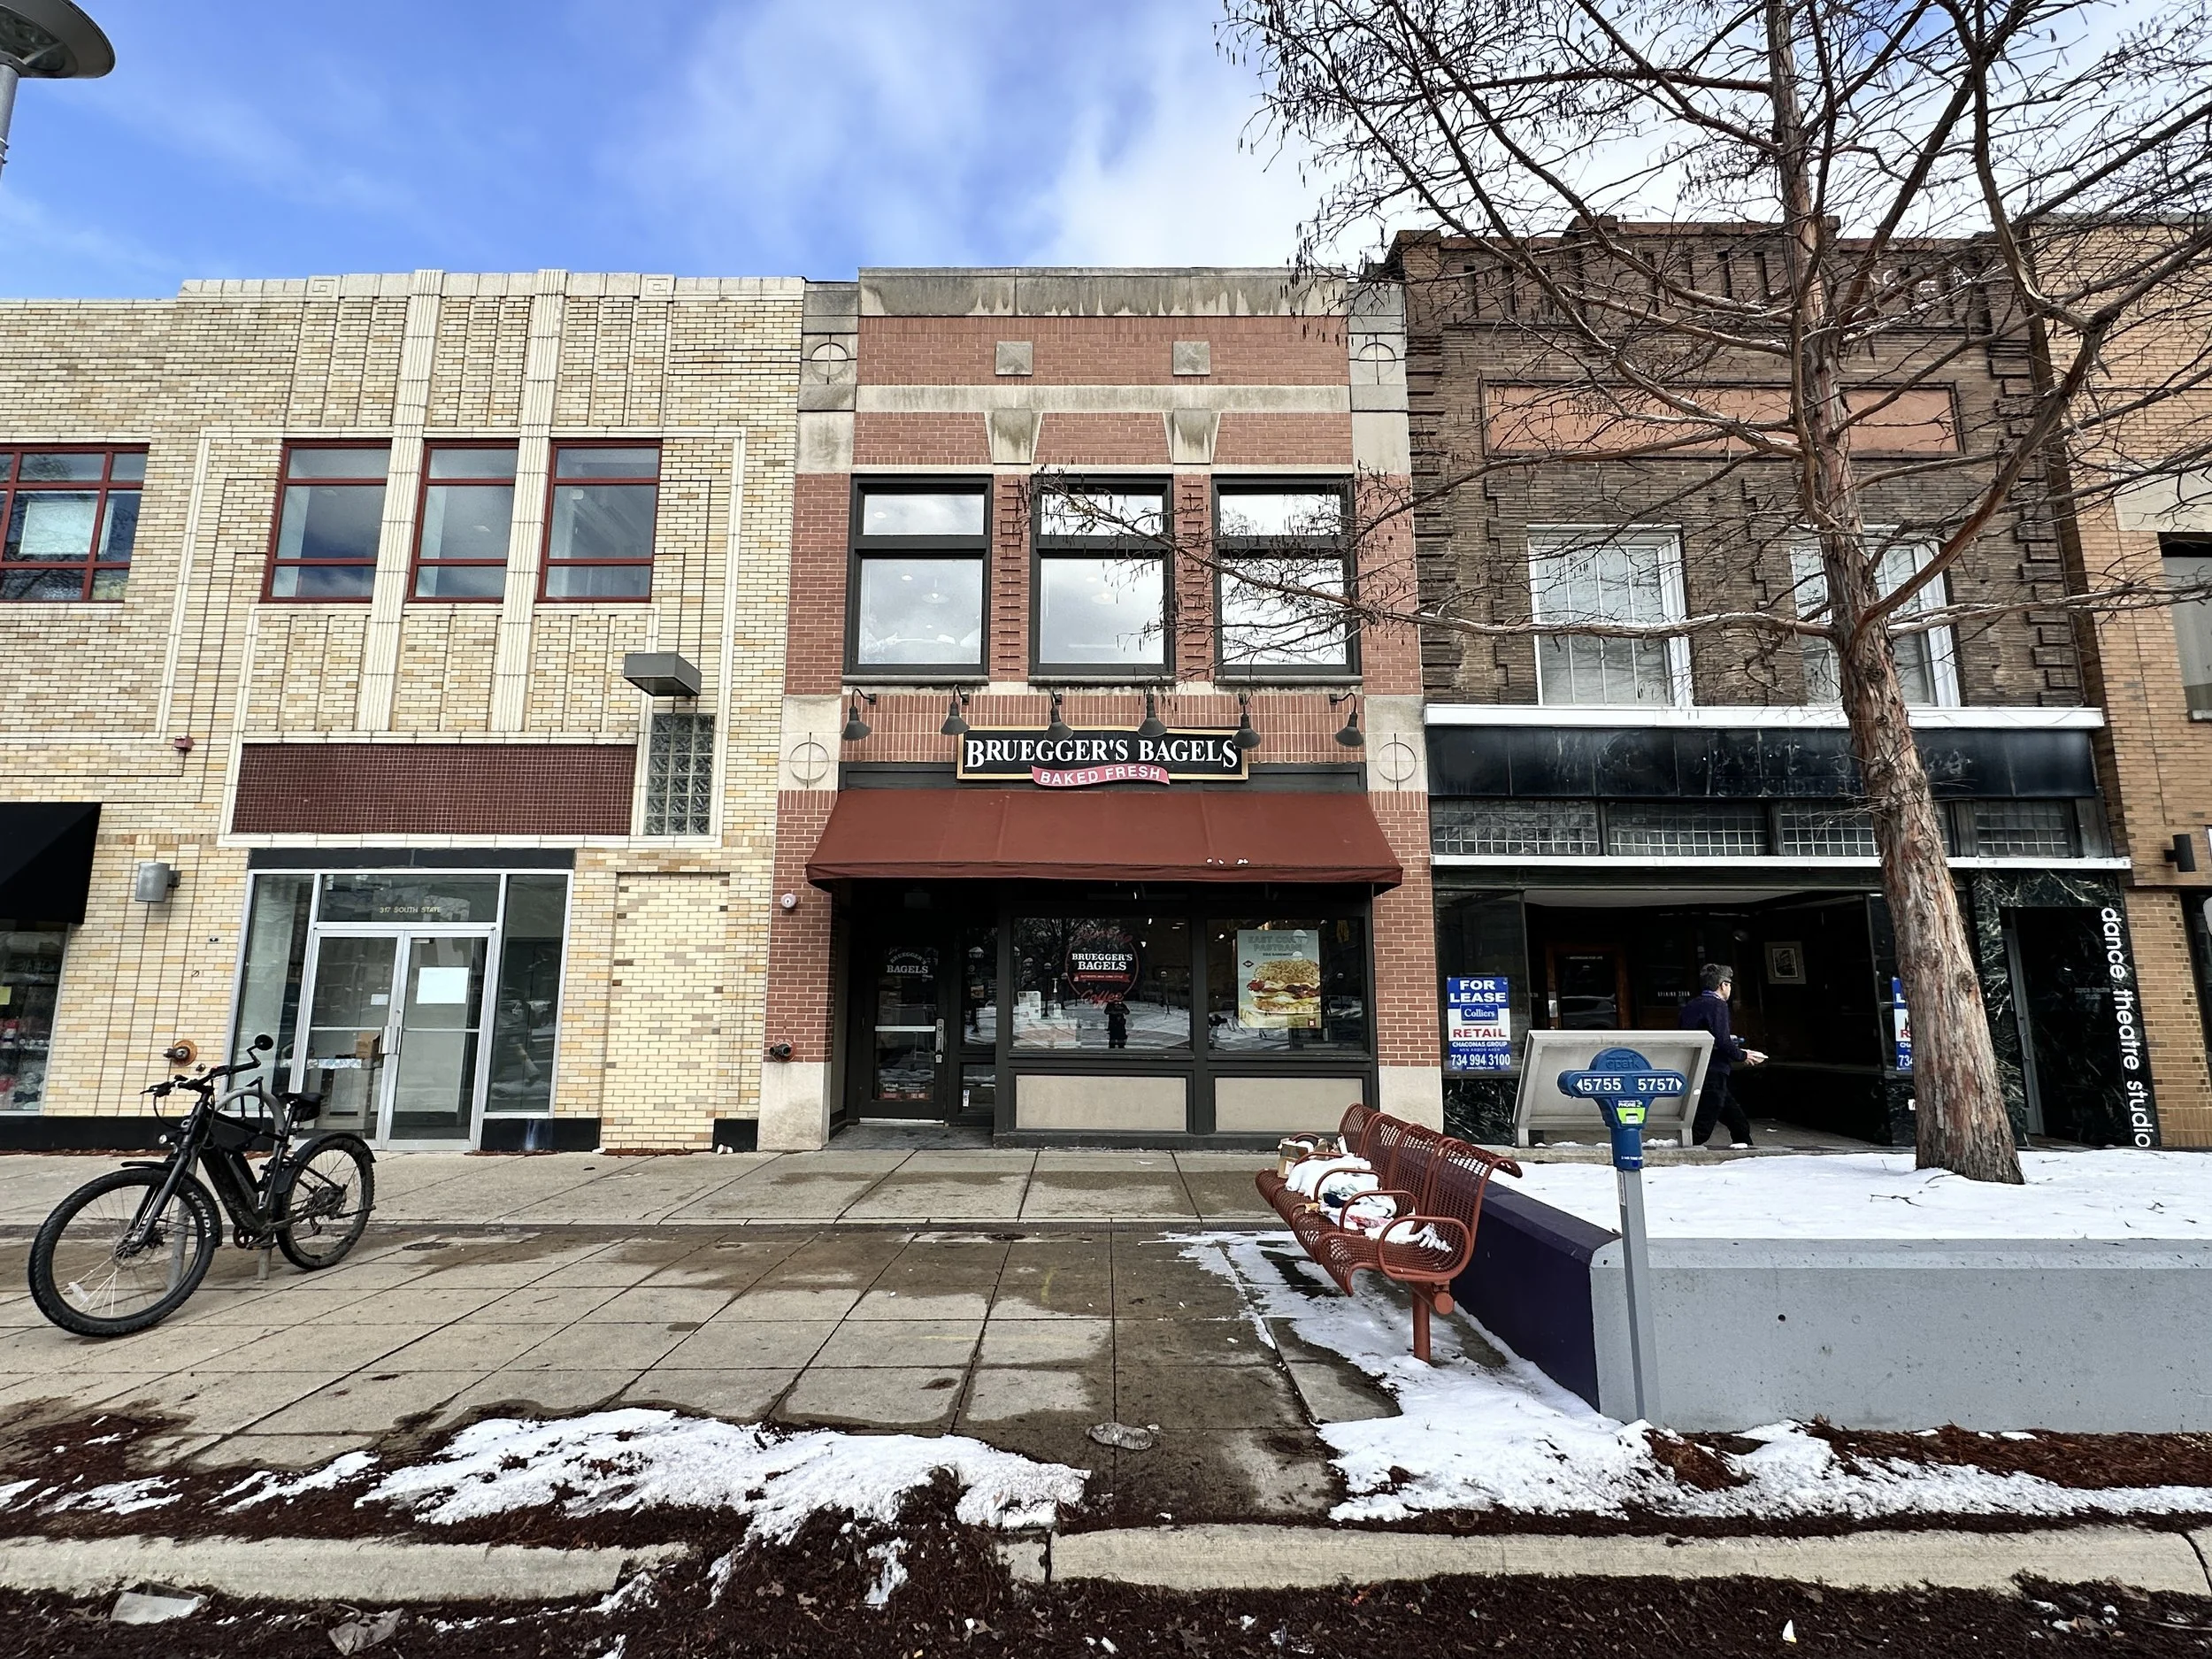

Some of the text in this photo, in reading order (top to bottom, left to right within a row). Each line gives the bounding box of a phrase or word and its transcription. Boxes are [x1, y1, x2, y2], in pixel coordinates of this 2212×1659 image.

[964, 739, 1238, 768] BRUEGGER'S BAGELS
[1040, 765, 1161, 785] BAKED FRESH
[1071, 953, 1133, 962] BRUEGGER'S
[887, 964, 928, 974] BAGELS
[1078, 961, 1127, 971] BAGELS
[1459, 979, 1496, 990] FOR
[1449, 992, 1507, 1003] LEASE
[1463, 1008, 1495, 1018] Colliers
[1452, 1028, 1507, 1038] RETAIL
[2101, 907, 2154, 1148] dance theatre studio
[1451, 1053, 1511, 1066] 734 994 3100
[1583, 1077, 1675, 1091] 5755 5757
[187, 1191, 212, 1239] KENDA
